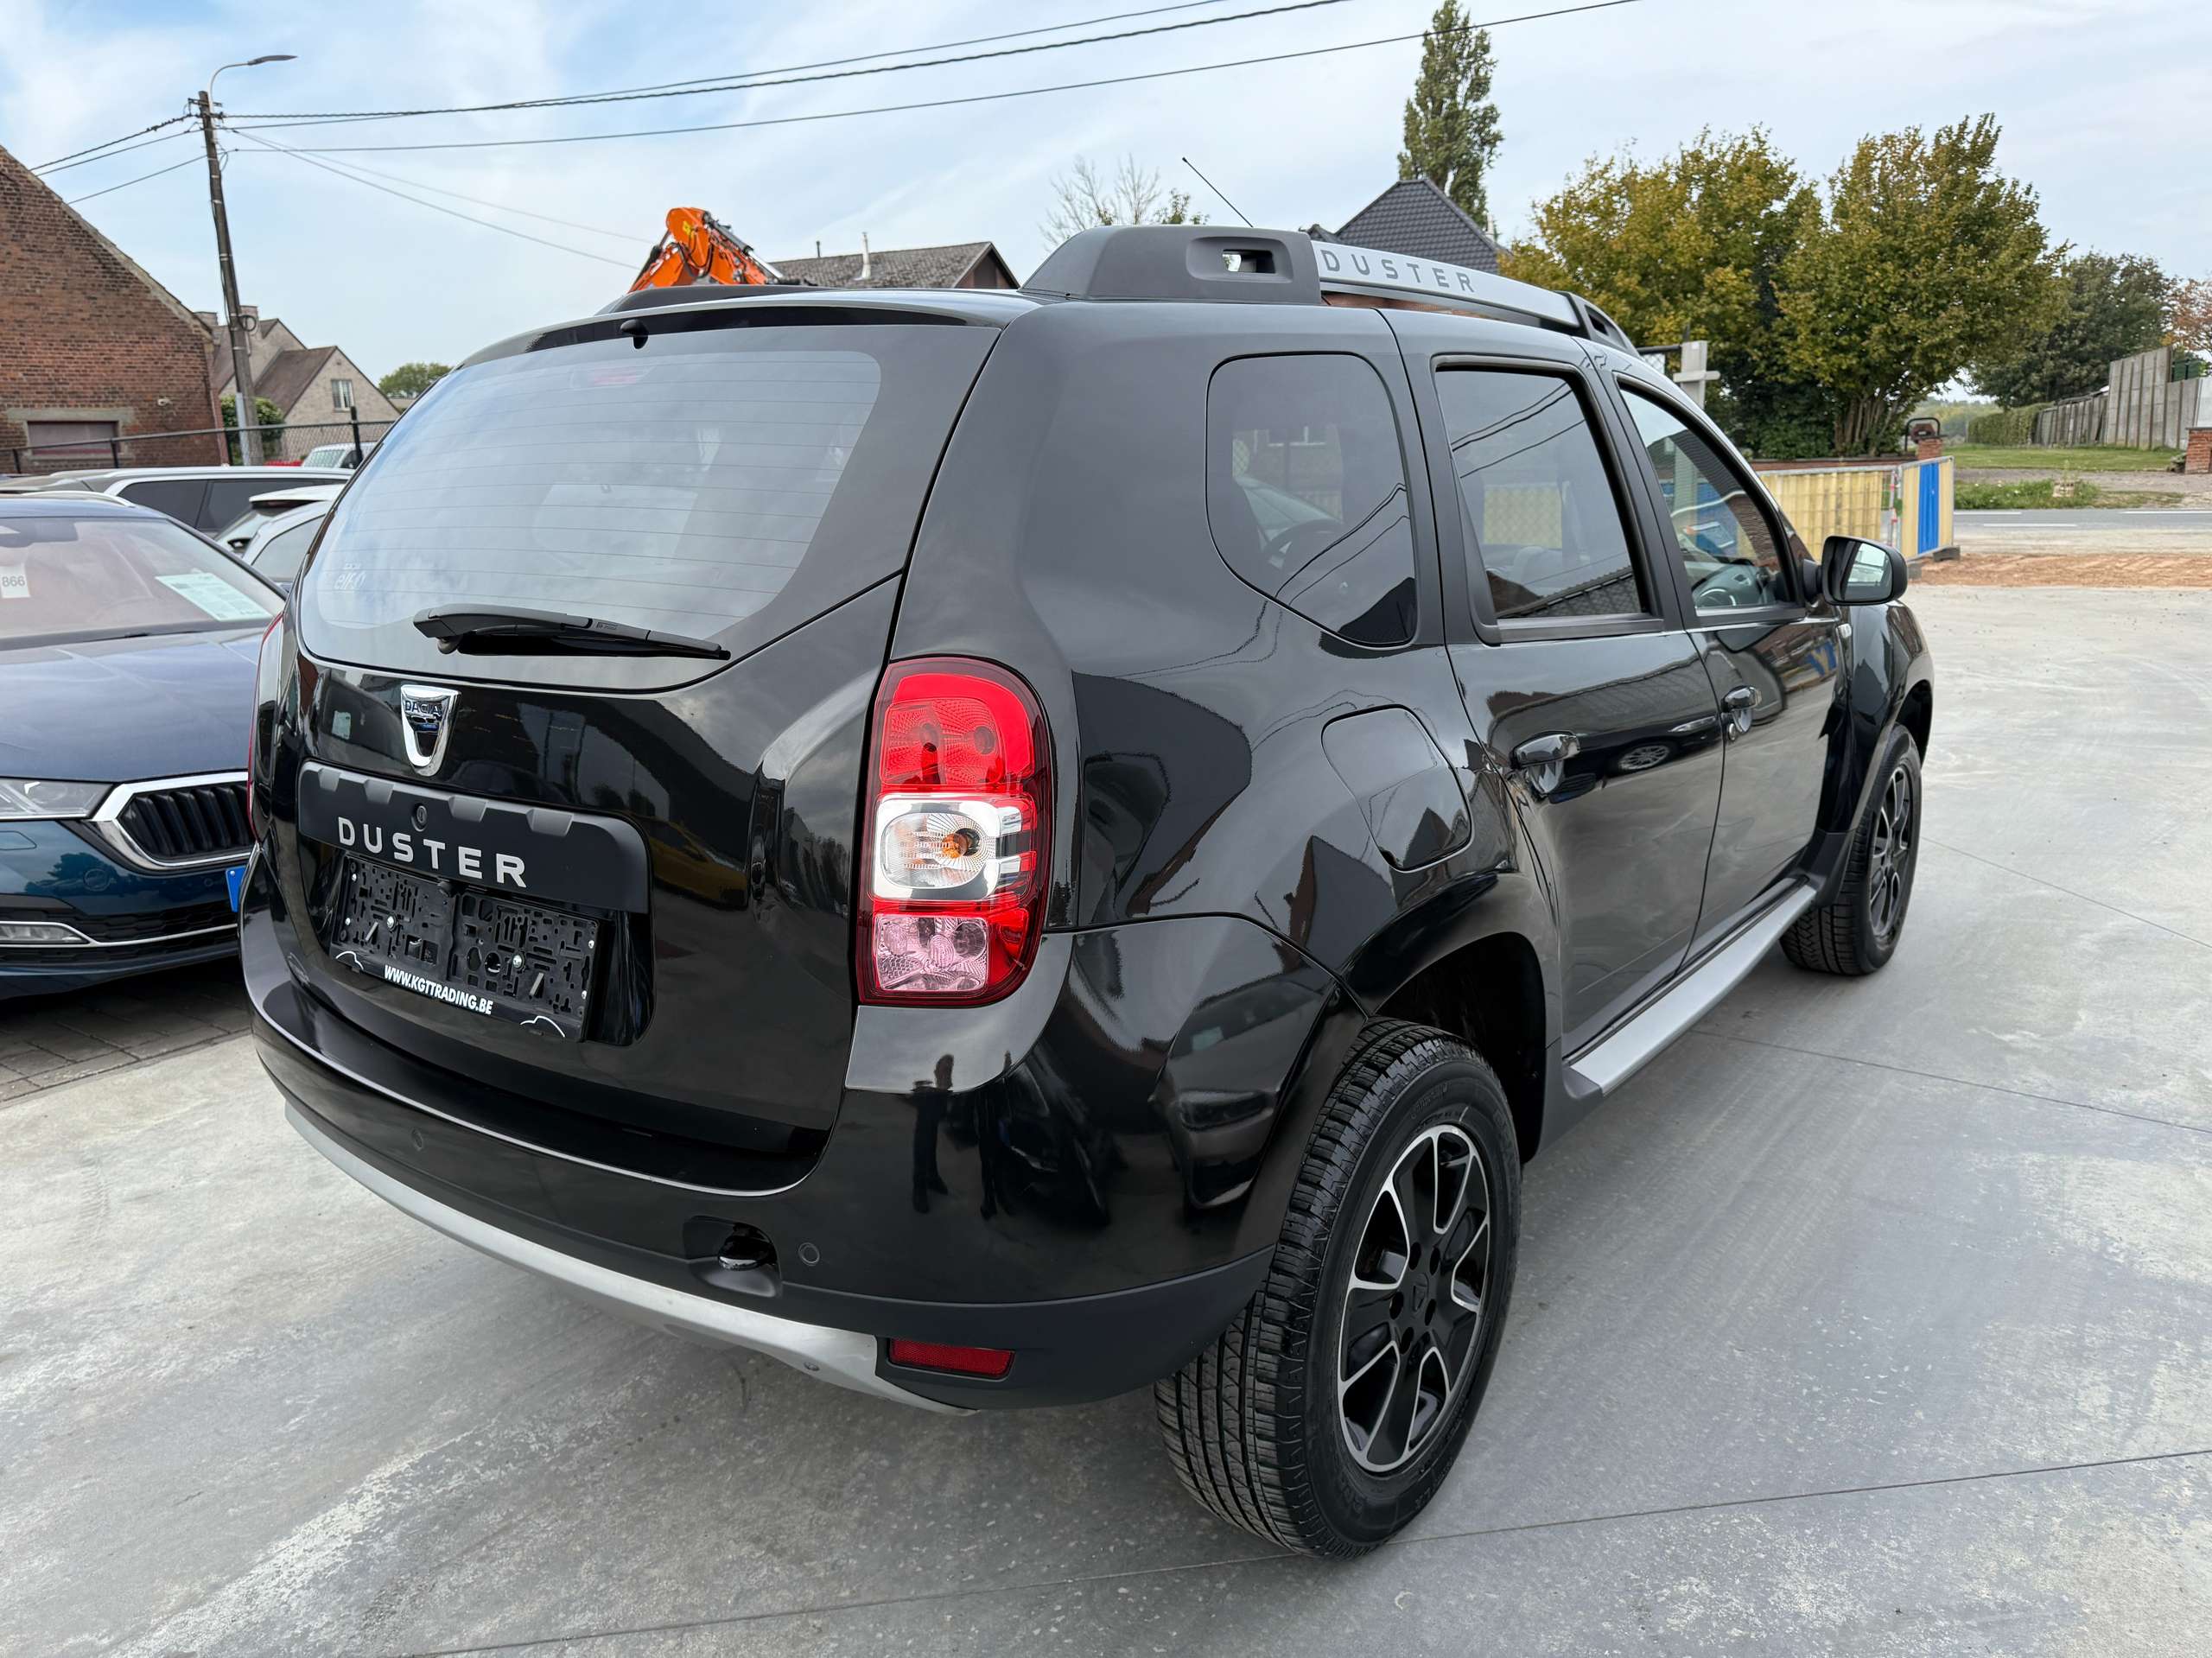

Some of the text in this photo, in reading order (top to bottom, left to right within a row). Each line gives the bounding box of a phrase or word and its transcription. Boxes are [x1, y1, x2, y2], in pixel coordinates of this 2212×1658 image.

[1320, 250, 1475, 293] DUSTER
[405, 700, 442, 717] DACIA
[338, 816, 527, 888] DUSTER
[385, 964, 493, 1015] WWW.KGTTRADING.BE
